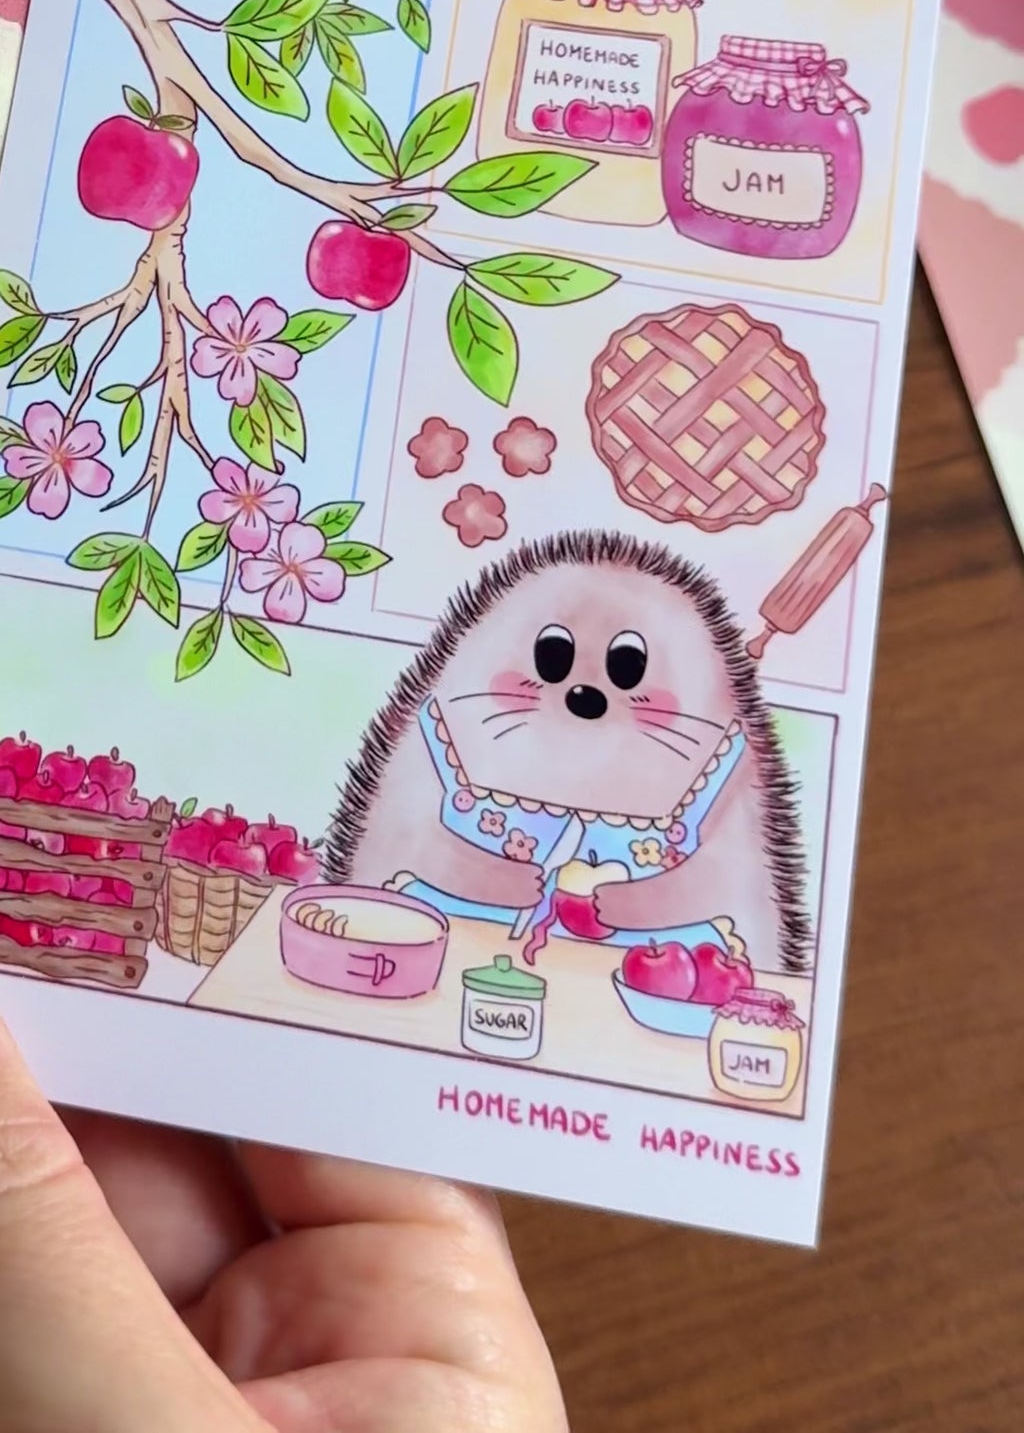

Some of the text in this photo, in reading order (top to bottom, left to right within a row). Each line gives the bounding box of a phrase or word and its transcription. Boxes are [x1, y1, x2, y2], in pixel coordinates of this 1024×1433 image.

[539, 38, 641, 68] HOMEMADE
[533, 69, 641, 95] HAPPINESS
[721, 167, 786, 196] JAM
[474, 1007, 529, 1033] SUGAR
[728, 1052, 771, 1075] JAM
[437, 1085, 802, 1178] HOMEMADE HAPPINESS
